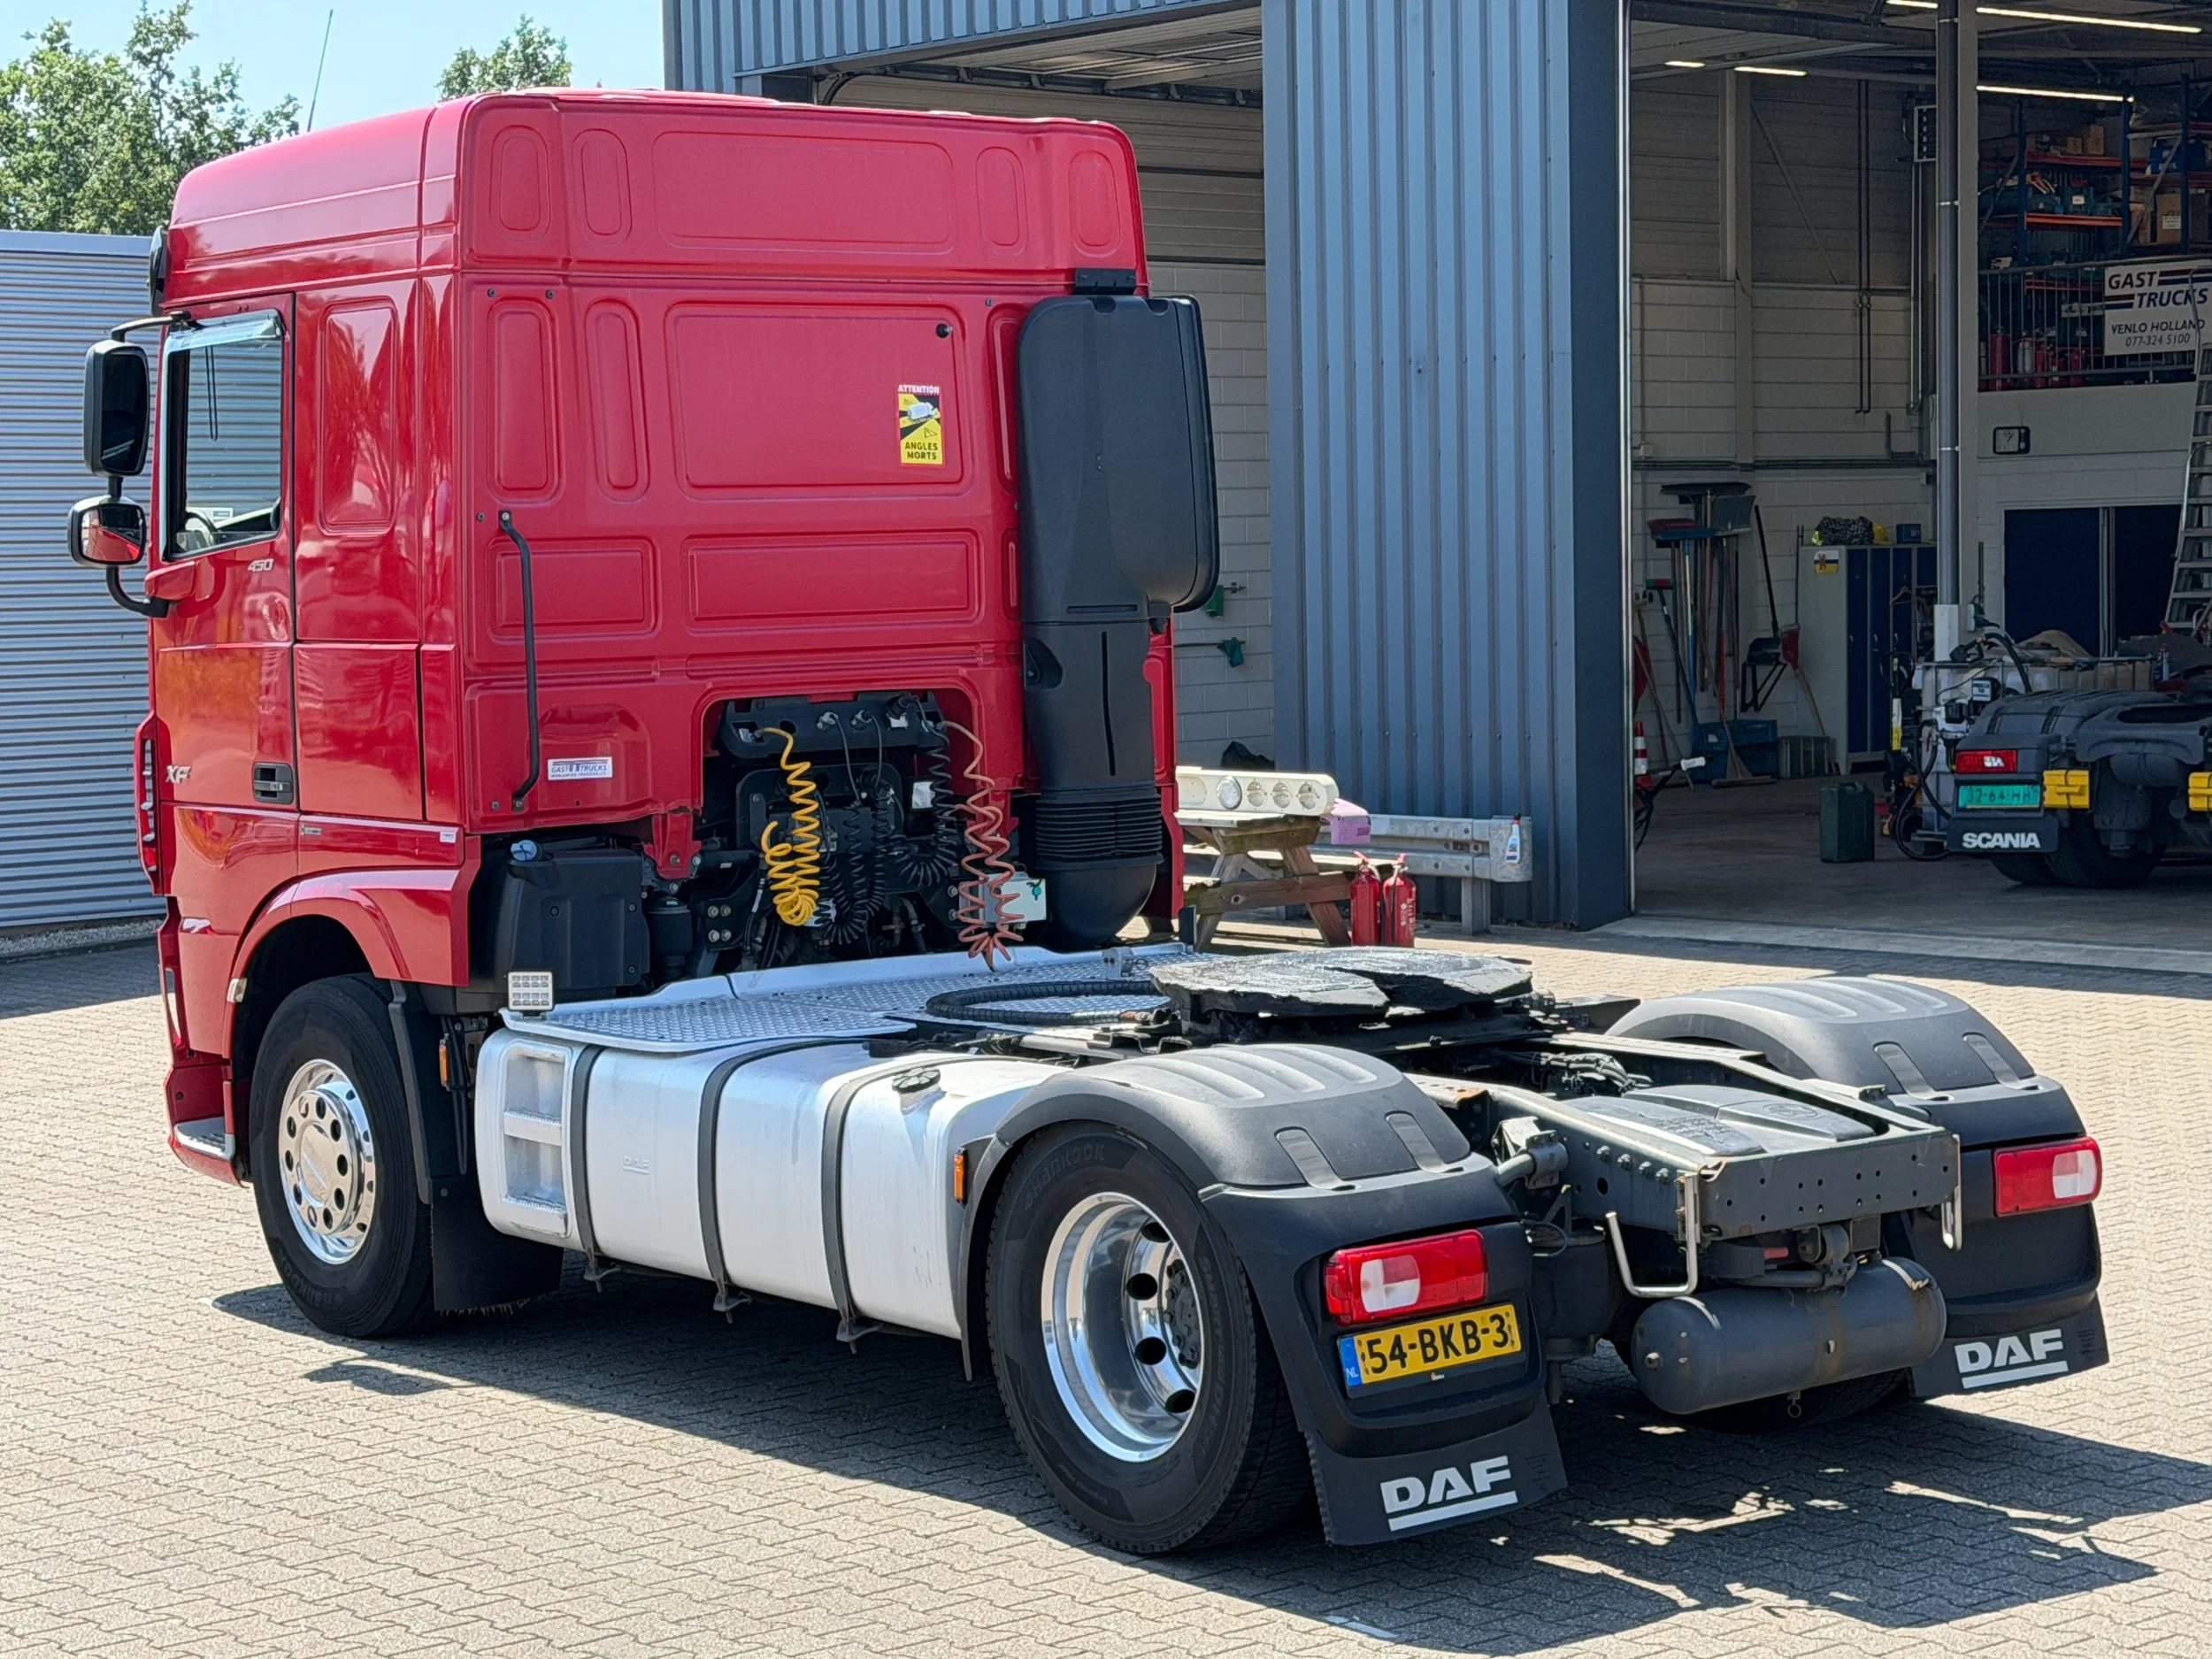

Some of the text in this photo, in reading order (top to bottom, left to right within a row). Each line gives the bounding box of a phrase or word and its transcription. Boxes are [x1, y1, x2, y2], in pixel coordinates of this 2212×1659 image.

[2108, 271, 2157, 290] GAST
[2137, 288, 2209, 309] TRUCKS
[2111, 319, 2206, 334] VENLO HOLLAND
[2125, 333, 2191, 347] 077-324 5100
[897, 384, 941, 395] ATTENTION
[904, 442, 939, 451] ANGLES
[907, 451, 938, 460] MORTS
[247, 557, 274, 572] 450
[165, 765, 191, 784] XF
[1962, 833, 2041, 849] SCANIA
[1366, 1313, 1509, 1375] 54-BKB-3
[1954, 1328, 2064, 1374] DAF
[1346, 1368, 1359, 1379] NL
[1379, 1455, 1511, 1515] DAF
